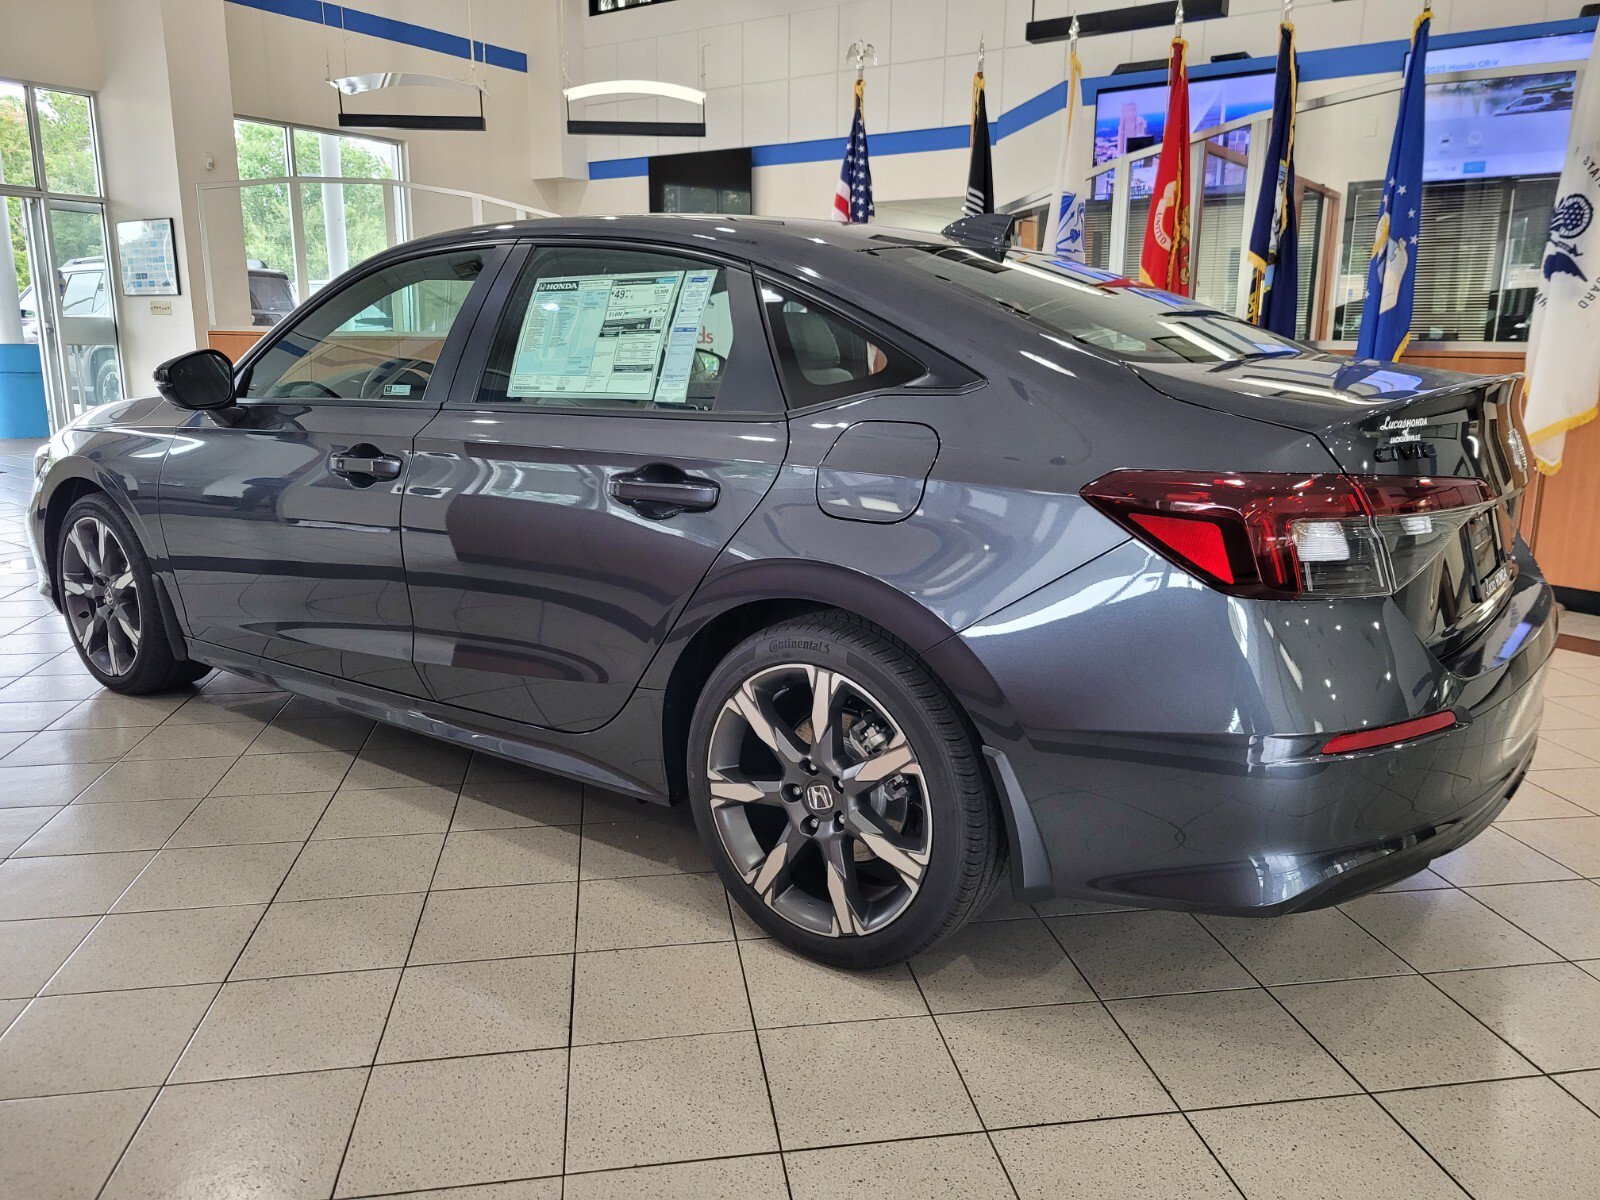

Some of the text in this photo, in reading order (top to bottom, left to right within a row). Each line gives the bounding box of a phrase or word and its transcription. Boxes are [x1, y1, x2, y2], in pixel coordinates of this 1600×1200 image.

[1449, 62, 1476, 71] Honda
[1477, 59, 1499, 68] CR-V
[1155, 212, 1167, 245] UNITED
[614, 290, 625, 299] 49
[1380, 416, 1428, 430] Lucas HONDA
[1390, 434, 1421, 444] JACKSONVILLE
[768, 639, 823, 653] Continental
